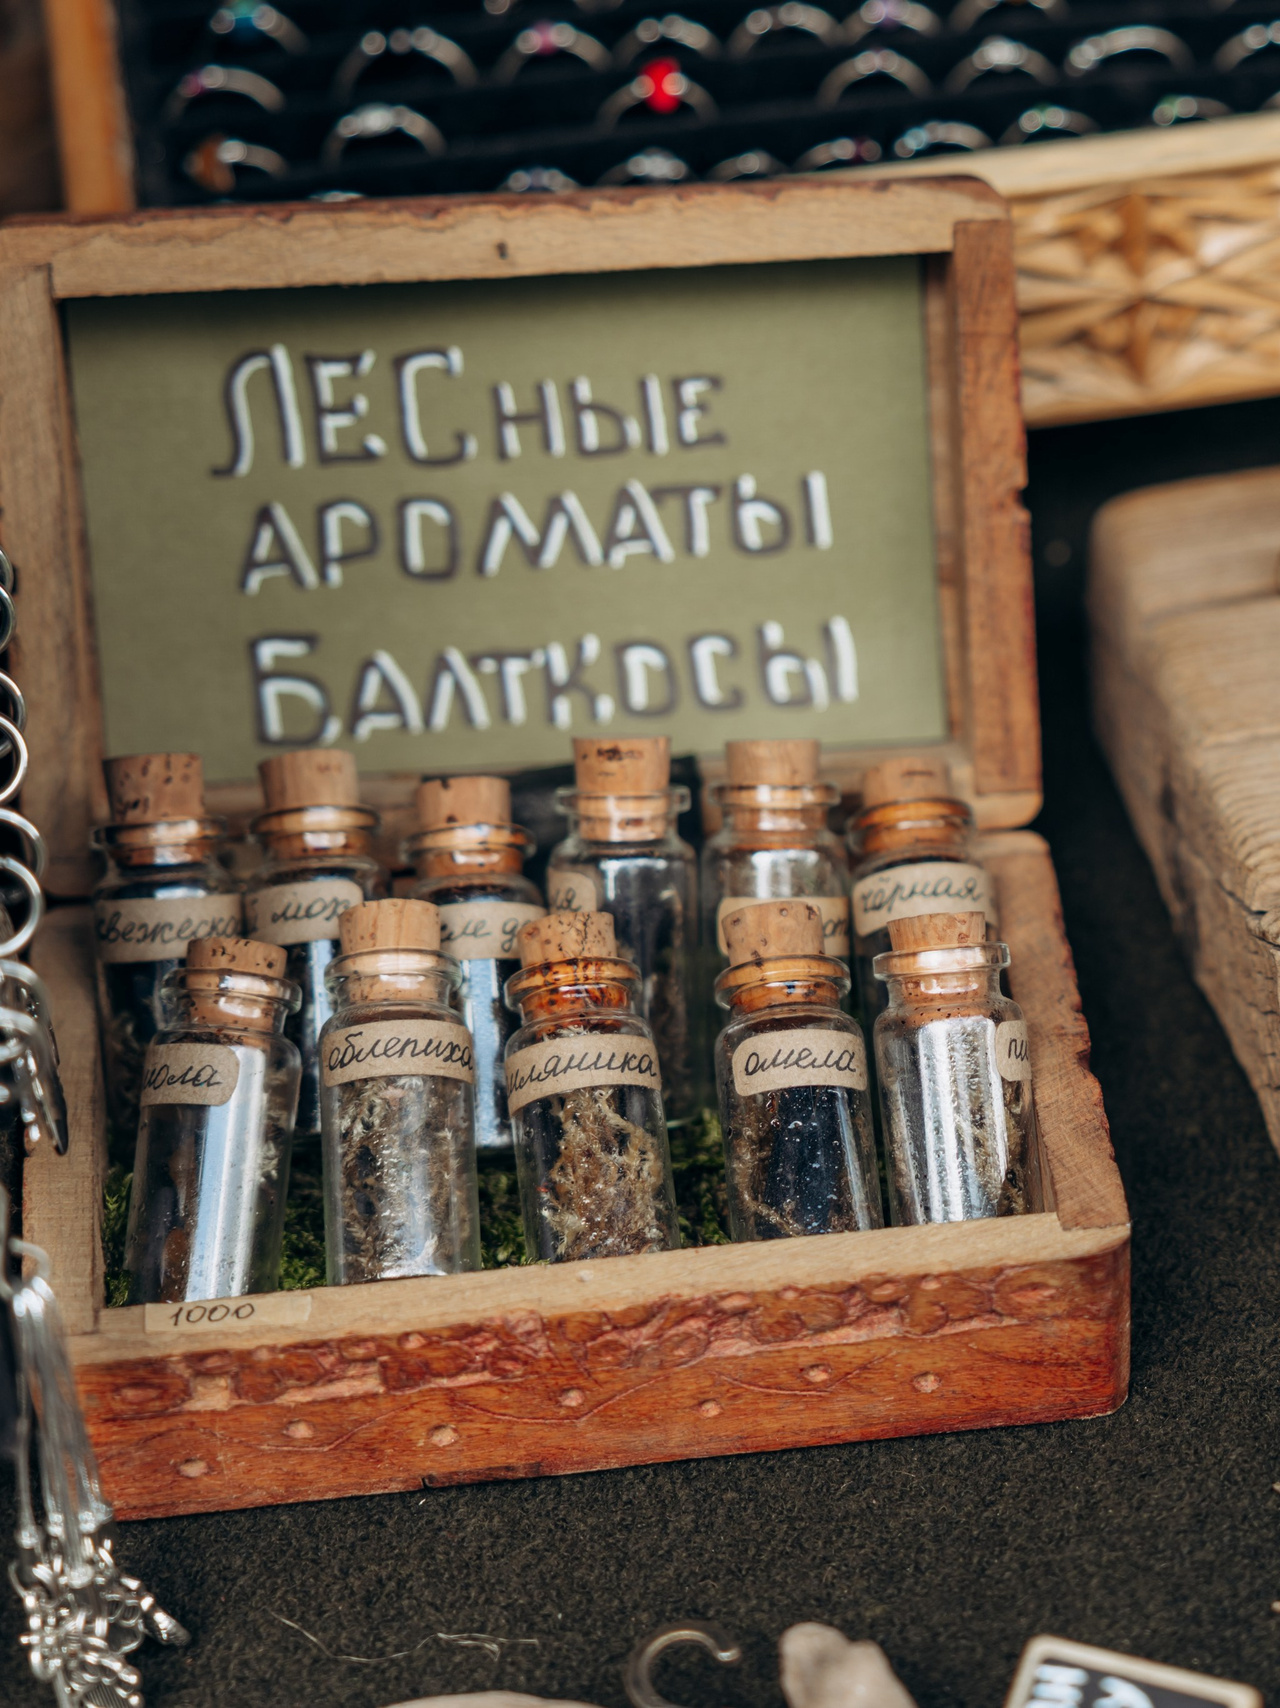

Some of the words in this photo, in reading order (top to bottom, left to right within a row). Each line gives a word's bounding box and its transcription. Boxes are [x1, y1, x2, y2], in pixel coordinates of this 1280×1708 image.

[211, 344, 727, 478] ЛЕСНЫЕ
[239, 470, 834, 597] АРОМАТЫ
[327, 1031, 474, 1071] облепиха
[744, 1047, 857, 1076] омела
[169, 1302, 256, 1327] 1000
